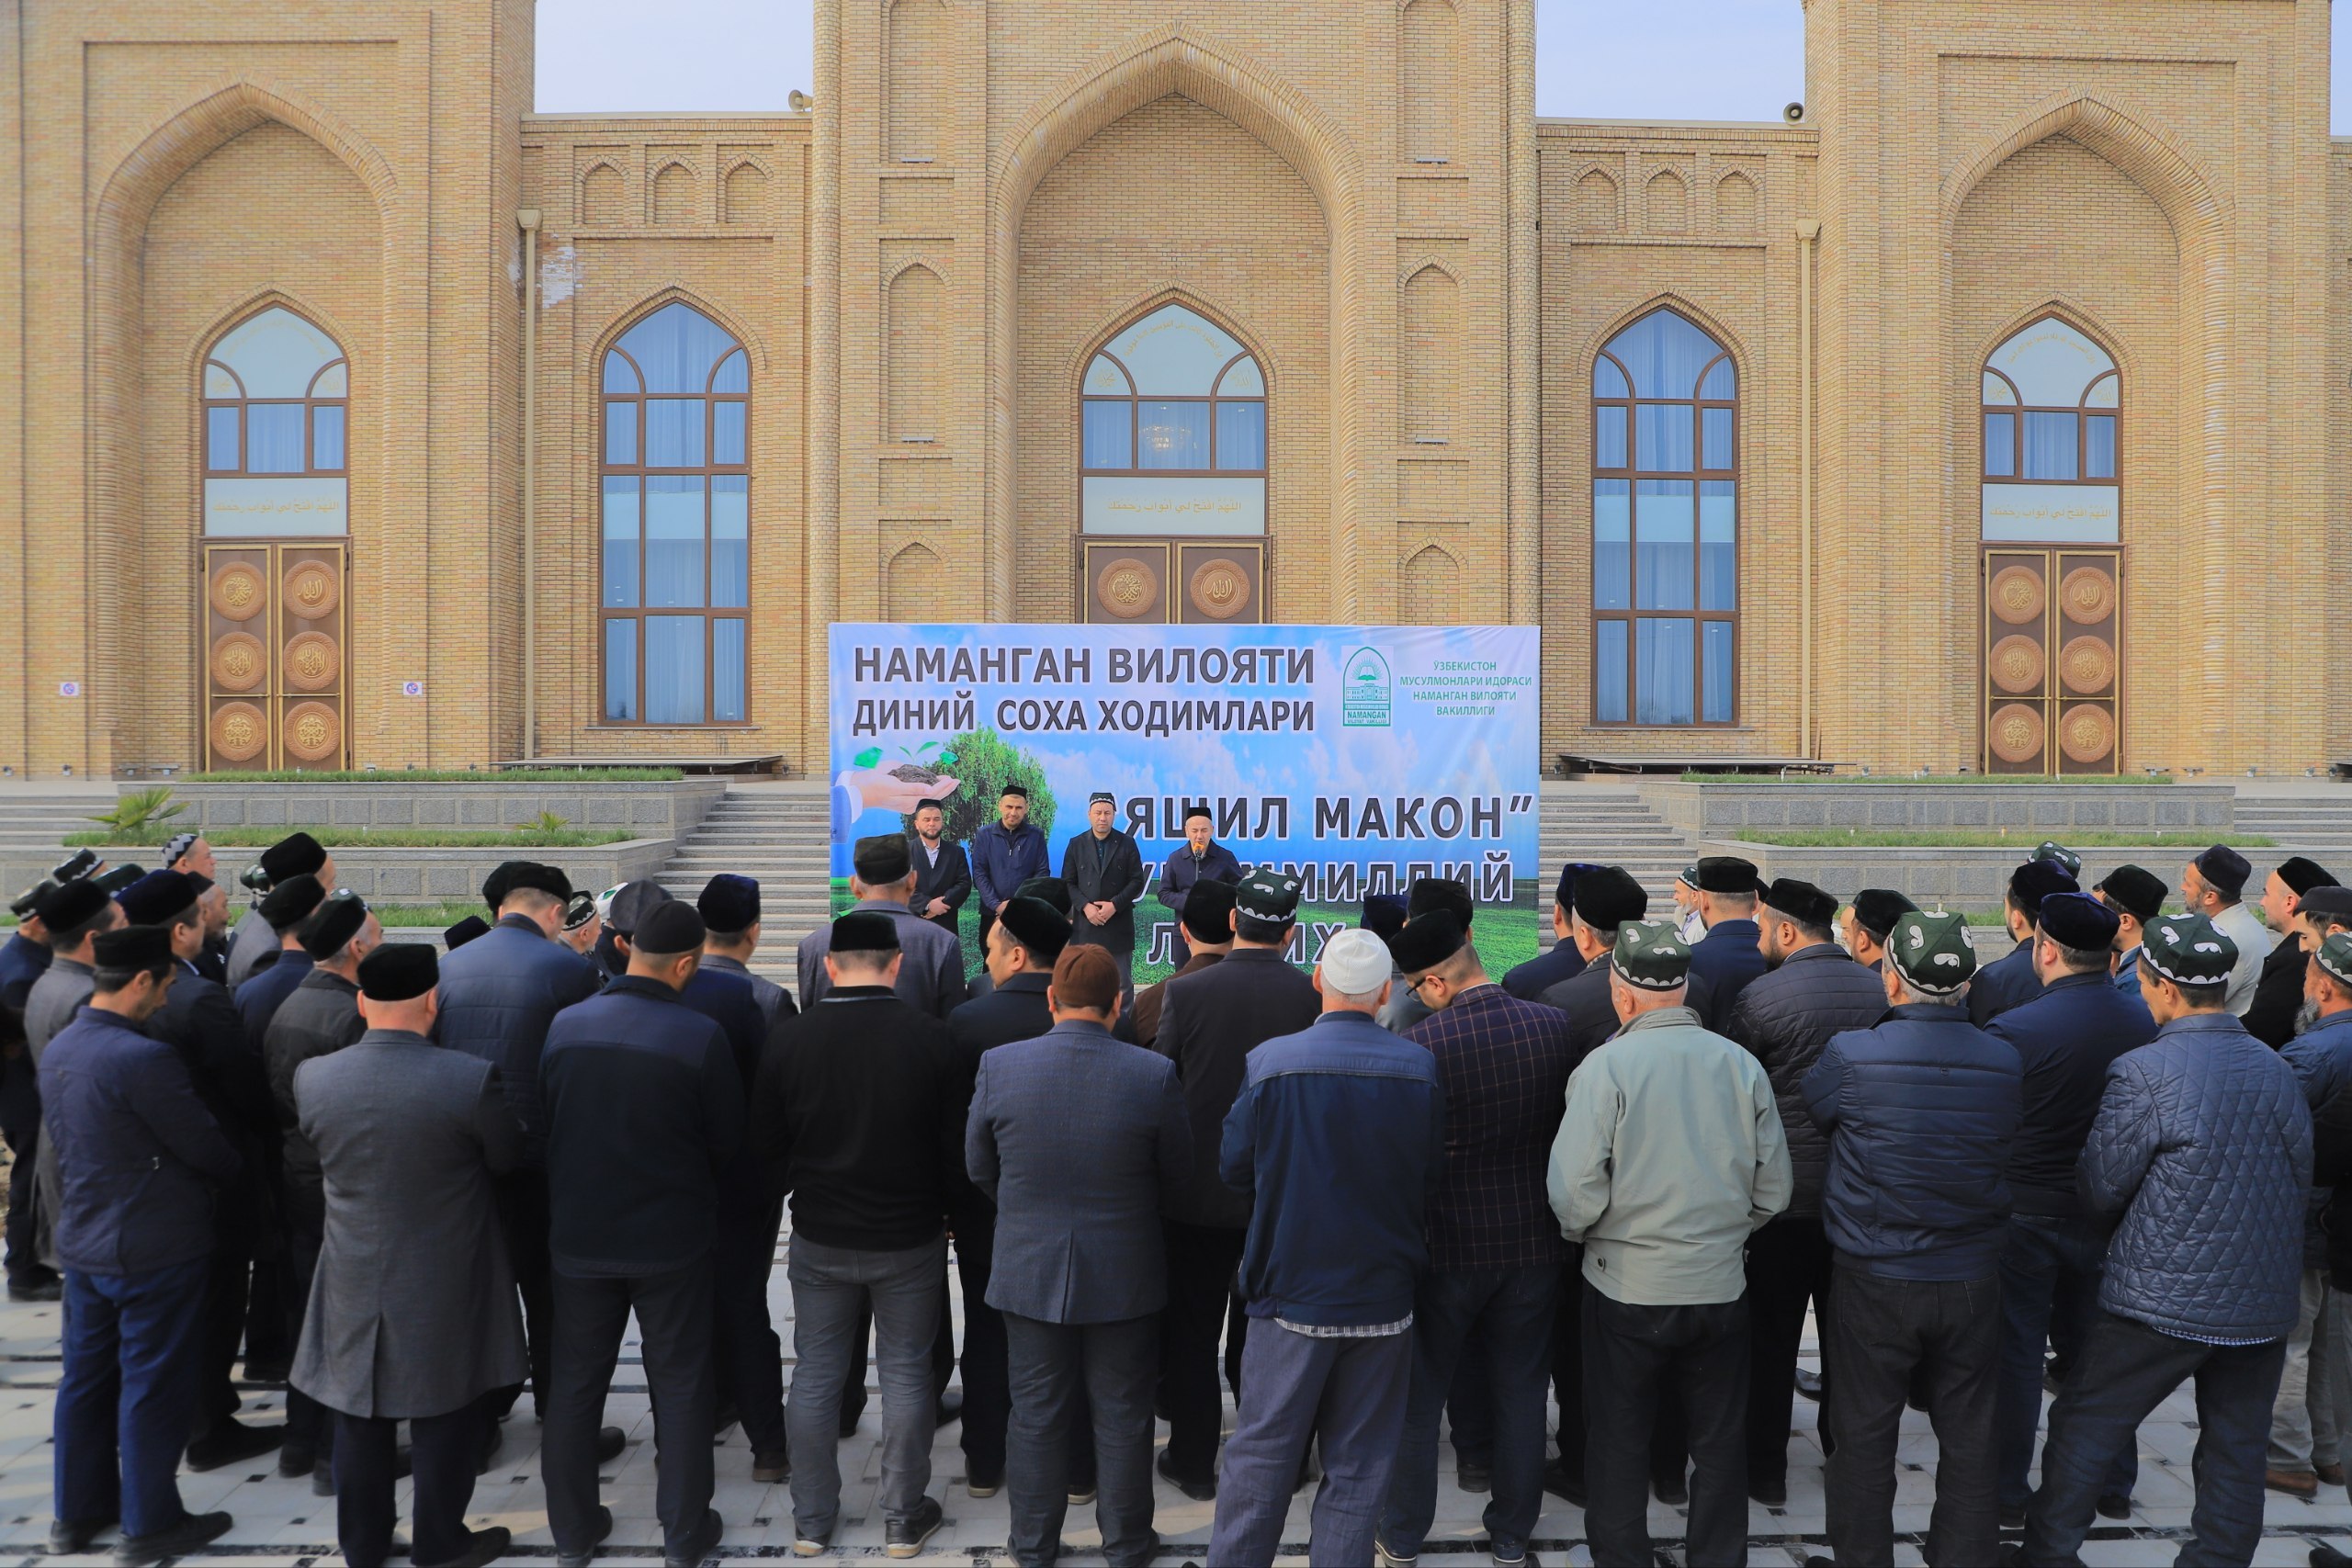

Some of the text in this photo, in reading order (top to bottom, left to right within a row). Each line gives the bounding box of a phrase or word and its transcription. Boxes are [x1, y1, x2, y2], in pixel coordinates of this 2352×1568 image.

[854, 647, 1314, 684] НАМАНГАН ВИЛОЯТИ
[1433, 660, 1497, 671] ЎЗБЕКИСТОН
[1399, 676, 1532, 688] МУСУЛМОНЛАРИ ИДОРАСИ
[1413, 691, 1517, 701] НАМАНГАН ВИЛОЯТИ
[853, 690, 1314, 738] ДИНИЙ СОХА ХОДИМЛАРИ
[1347, 710, 1386, 719] NAMANGAN
[1436, 705, 1496, 716] ВАКИЛЛИГИ
